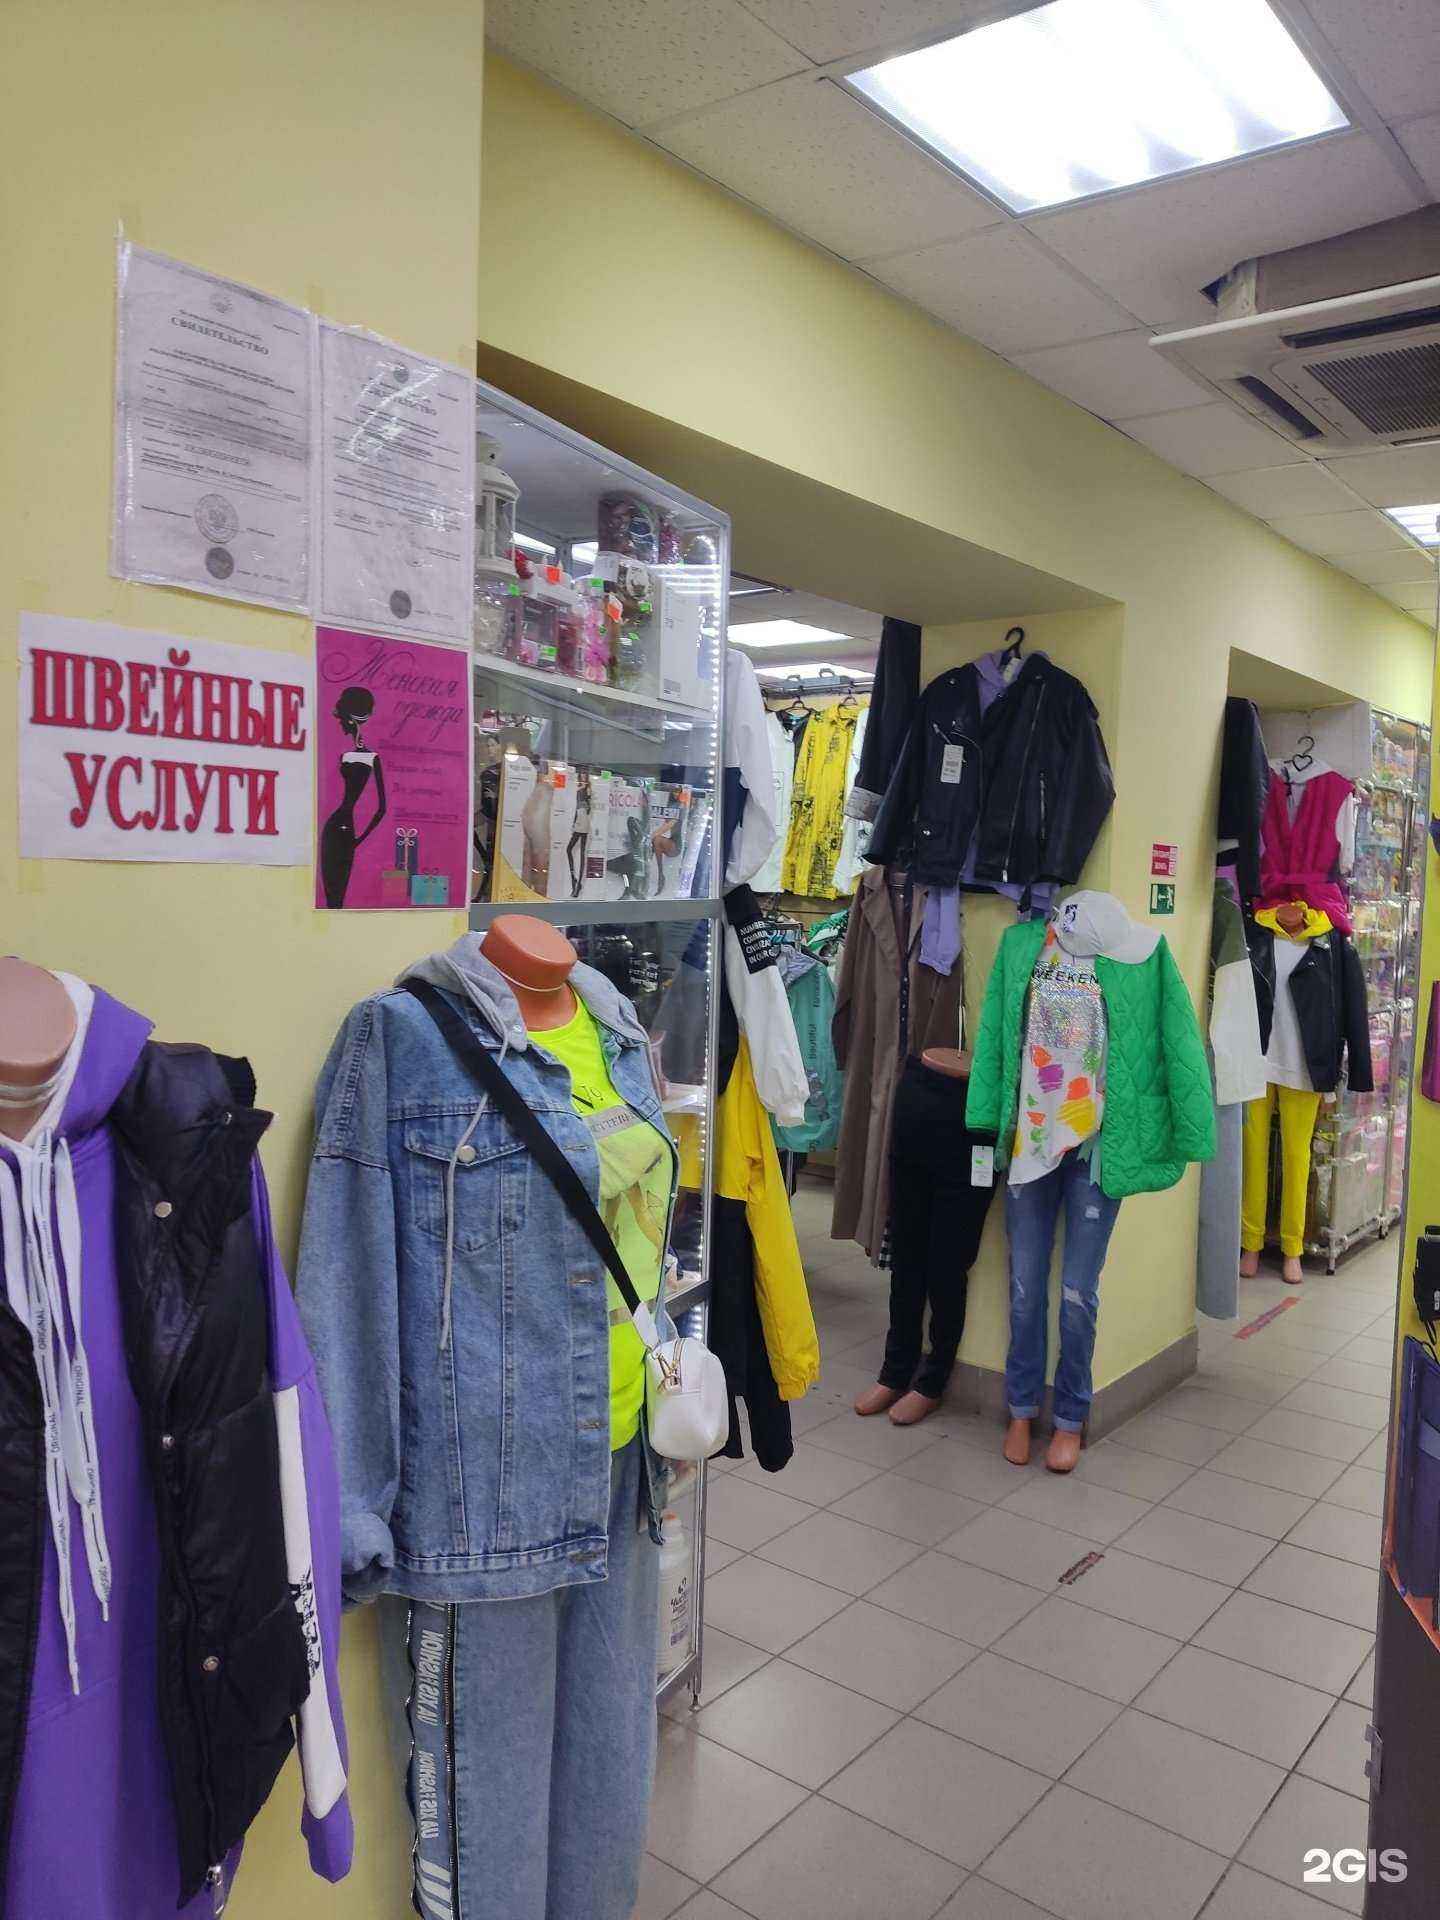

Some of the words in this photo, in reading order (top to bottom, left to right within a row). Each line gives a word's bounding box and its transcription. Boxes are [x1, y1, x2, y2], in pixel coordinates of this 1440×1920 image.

[321, 640, 459, 697] Женская
[30, 647, 306, 752] ШВЕЙНЫЕ
[64, 752, 279, 836] УСЛУГИ
[36, 1309, 46, 1350] ORIGINAL
[75, 1365, 85, 1405] ORIGINAL
[49, 1413, 60, 1453] ORIGINAL
